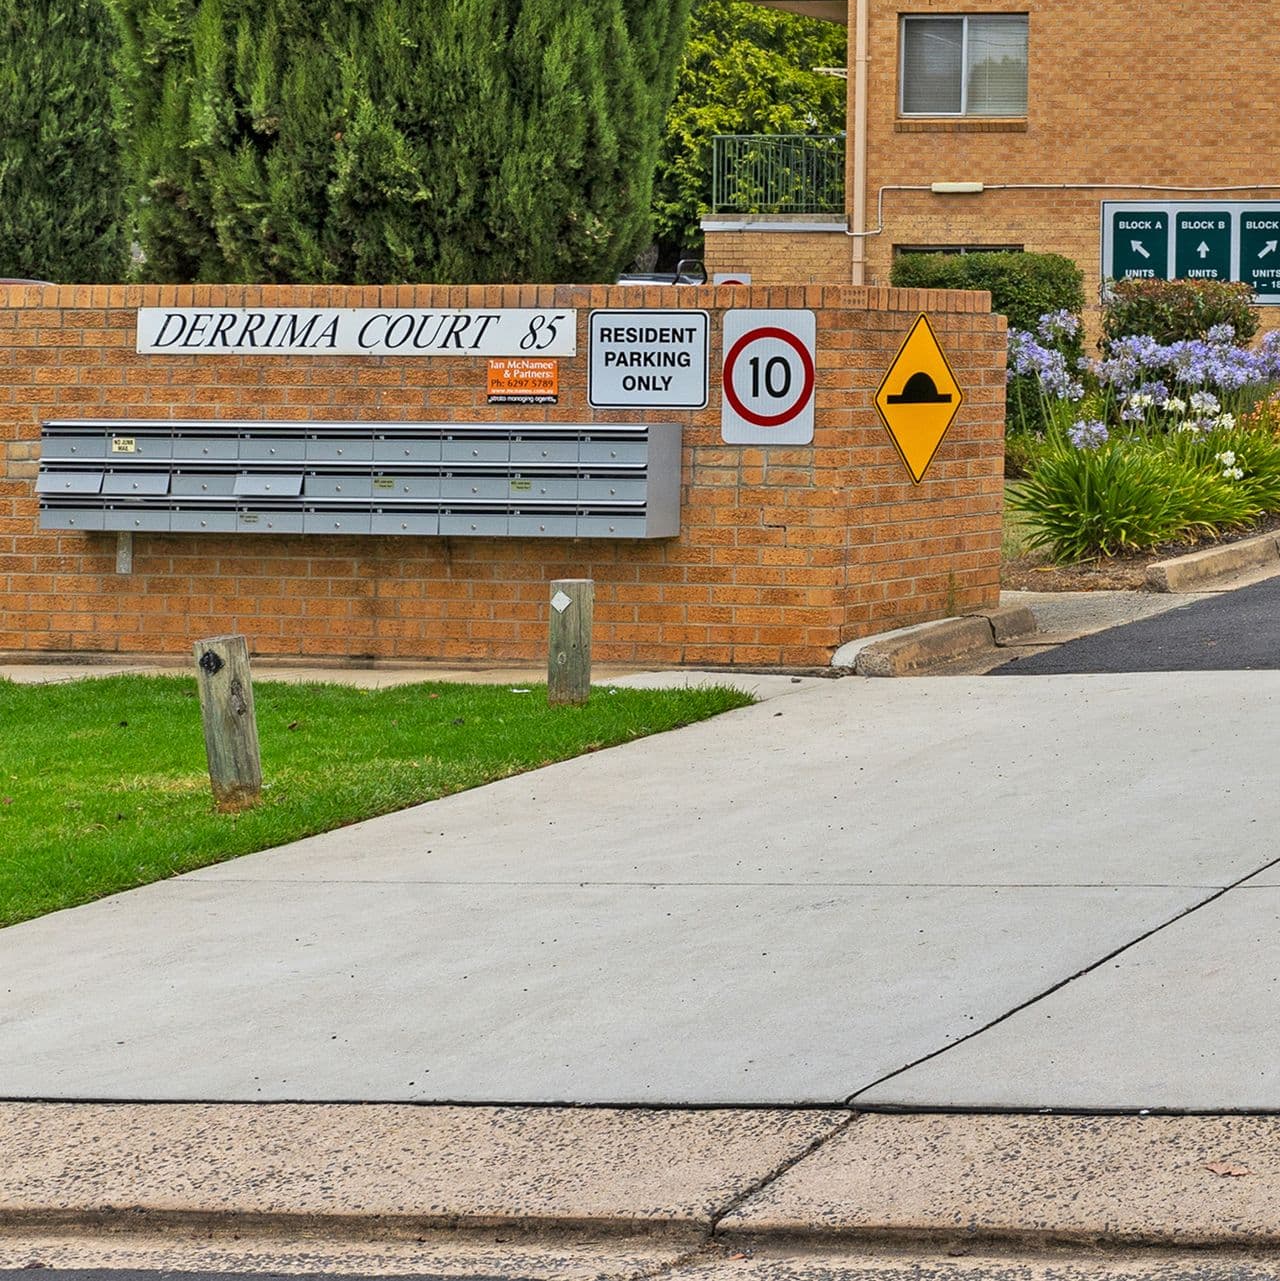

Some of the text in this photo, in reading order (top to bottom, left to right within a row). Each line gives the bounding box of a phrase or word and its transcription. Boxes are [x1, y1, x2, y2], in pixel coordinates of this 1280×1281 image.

[1118, 220, 1163, 230] BLOCK A
[1181, 220, 1226, 230] BLOCK B
[1245, 220, 1279, 230] BLOCK
[1125, 269, 1155, 278] UNITS
[1188, 269, 1218, 278] UNITS
[150, 313, 565, 350] DERRIMA COURT 85
[599, 327, 697, 344] RESIDENT
[604, 351, 691, 368] PARKING
[508, 361, 554, 369] McNamee
[503, 370, 511, 378] &
[749, 356, 792, 399] 10
[491, 380, 554, 388] Ph: 6297 5789
[622, 375, 673, 392] ONLY
